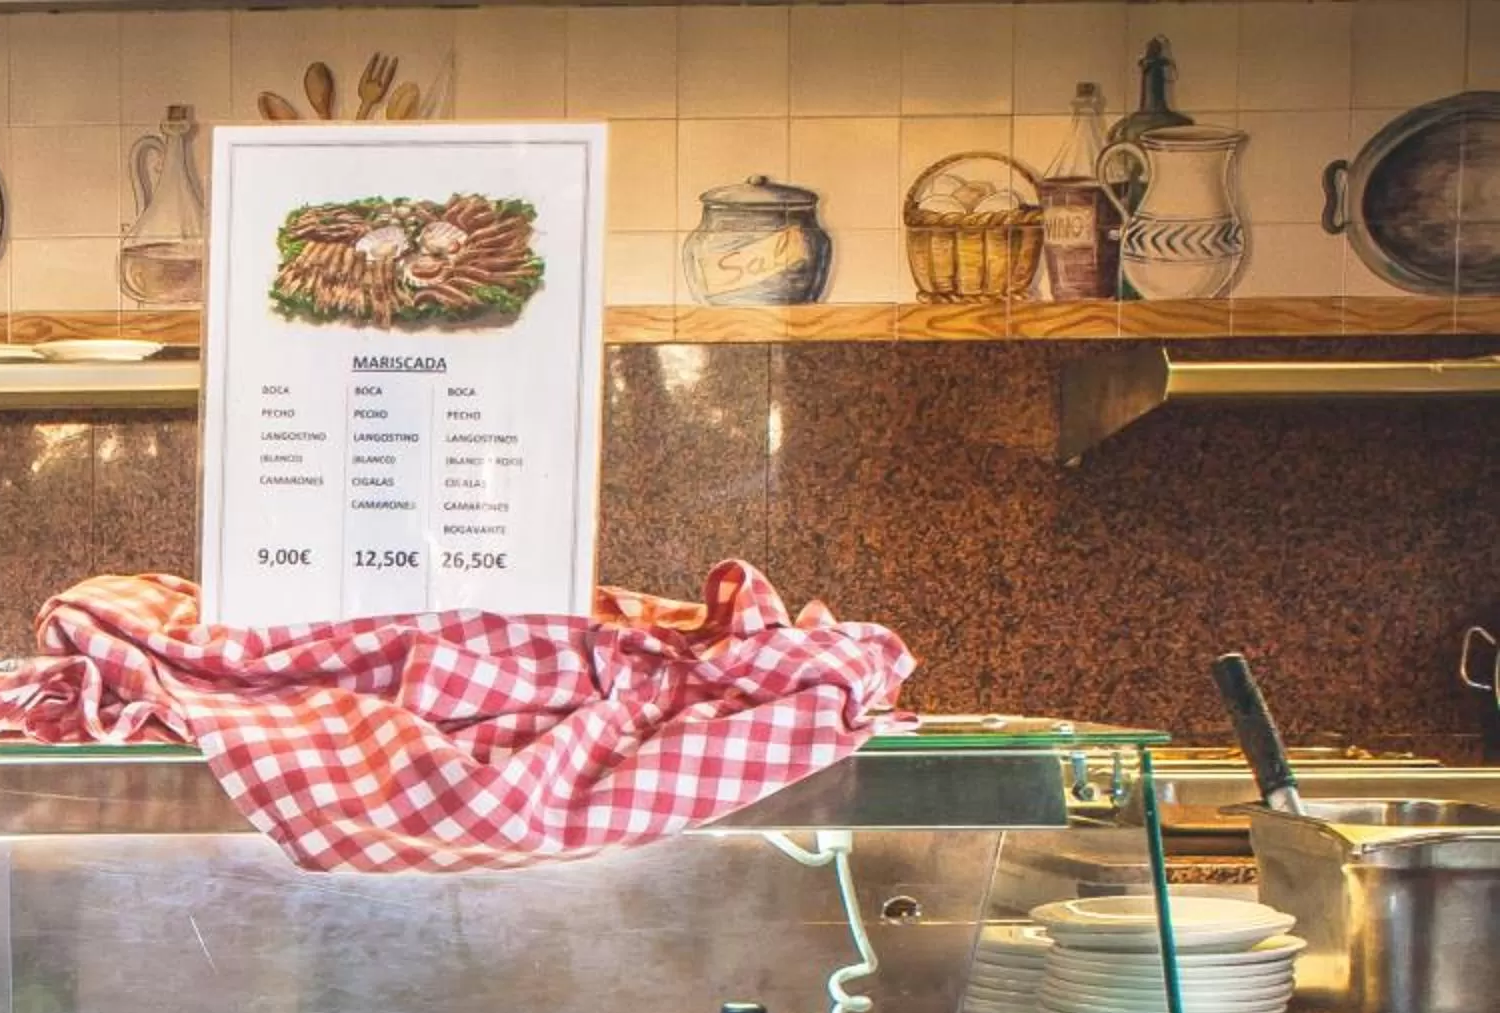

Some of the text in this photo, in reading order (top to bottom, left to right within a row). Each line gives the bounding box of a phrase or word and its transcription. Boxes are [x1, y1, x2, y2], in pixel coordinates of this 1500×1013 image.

[351, 356, 448, 372] MARISCADA
[261, 384, 290, 396] BOCA
[354, 386, 383, 396] BOCA
[447, 387, 476, 397] BOCA
[261, 408, 295, 419] PECHO
[353, 409, 388, 419] PECHO
[446, 410, 481, 420] PECHO
[353, 432, 420, 444] LANGOSTINO
[352, 476, 394, 487] CIGALAS
[257, 548, 312, 568] 9,00€
[354, 550, 420, 570] 12,50€
[440, 551, 508, 571] 26,50€
